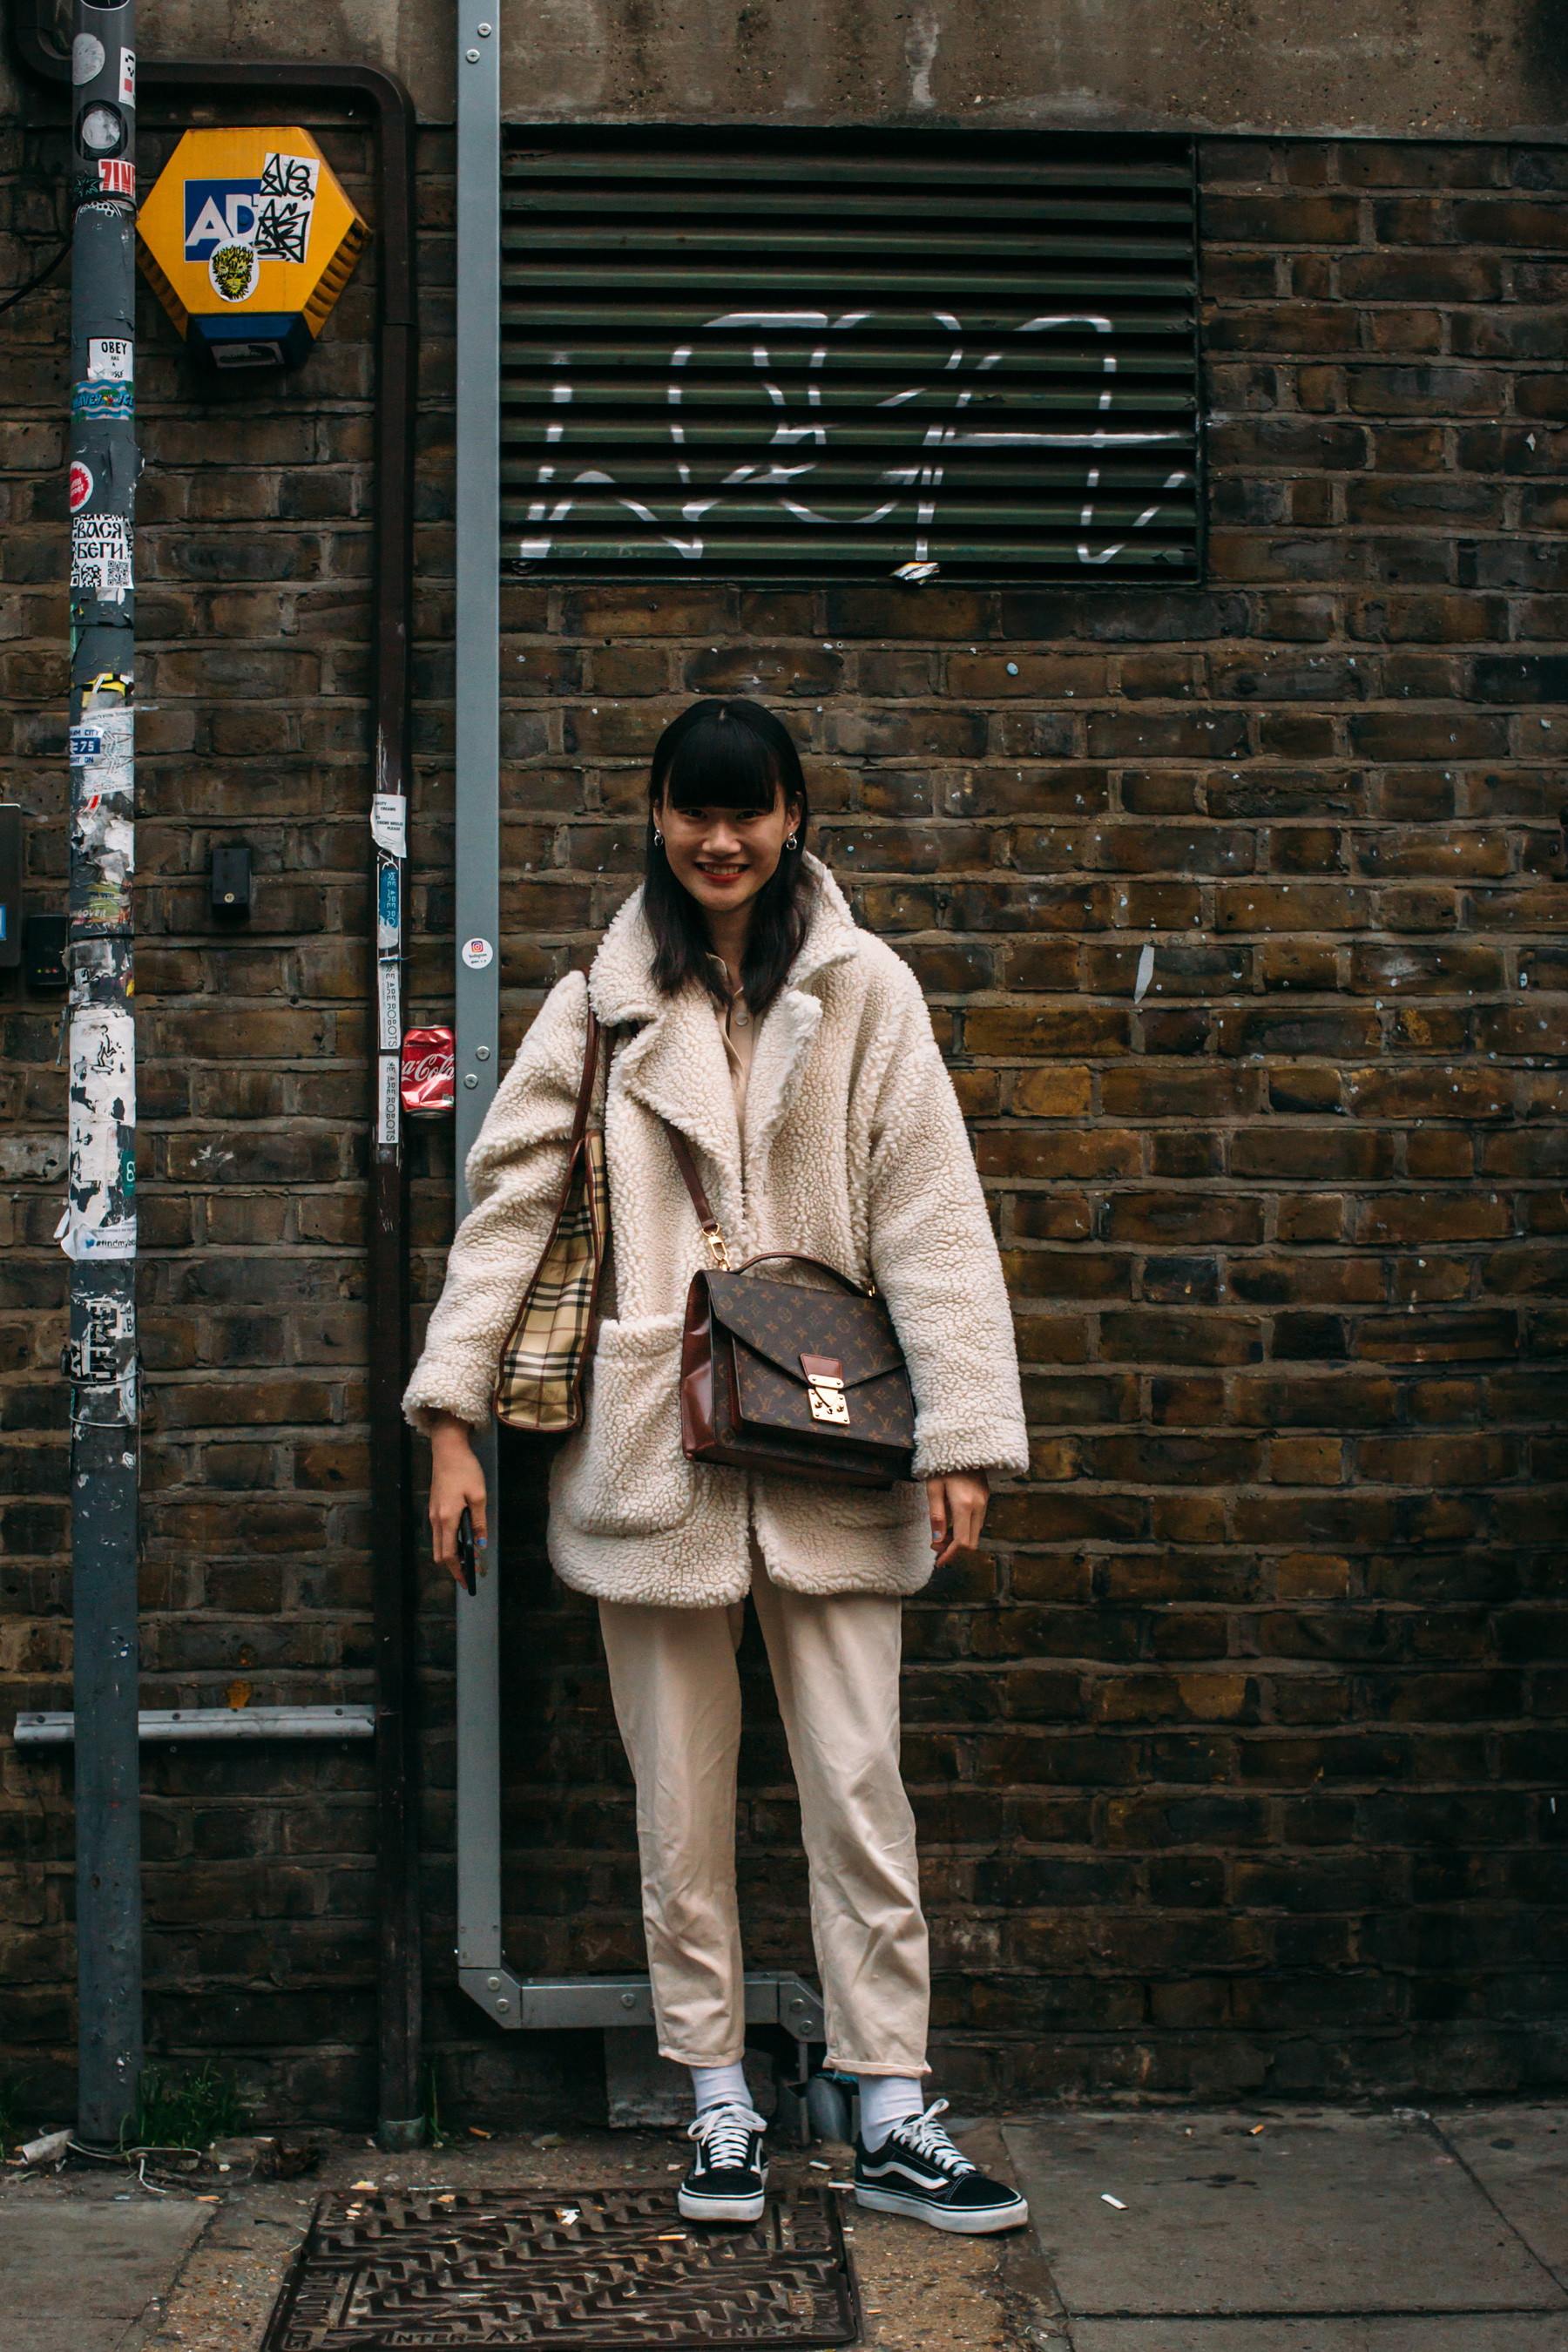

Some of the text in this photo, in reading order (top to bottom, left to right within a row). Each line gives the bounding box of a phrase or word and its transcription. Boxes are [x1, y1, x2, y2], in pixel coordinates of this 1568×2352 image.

[101, 341, 127, 355] OBEY
[77, 542, 123, 559] БЕГИ
[386, 982, 396, 1002] ARE
[387, 1003, 397, 1048] ROBOTS
[386, 1075, 395, 1095] ARE
[386, 1097, 395, 1142] ROBOTS
